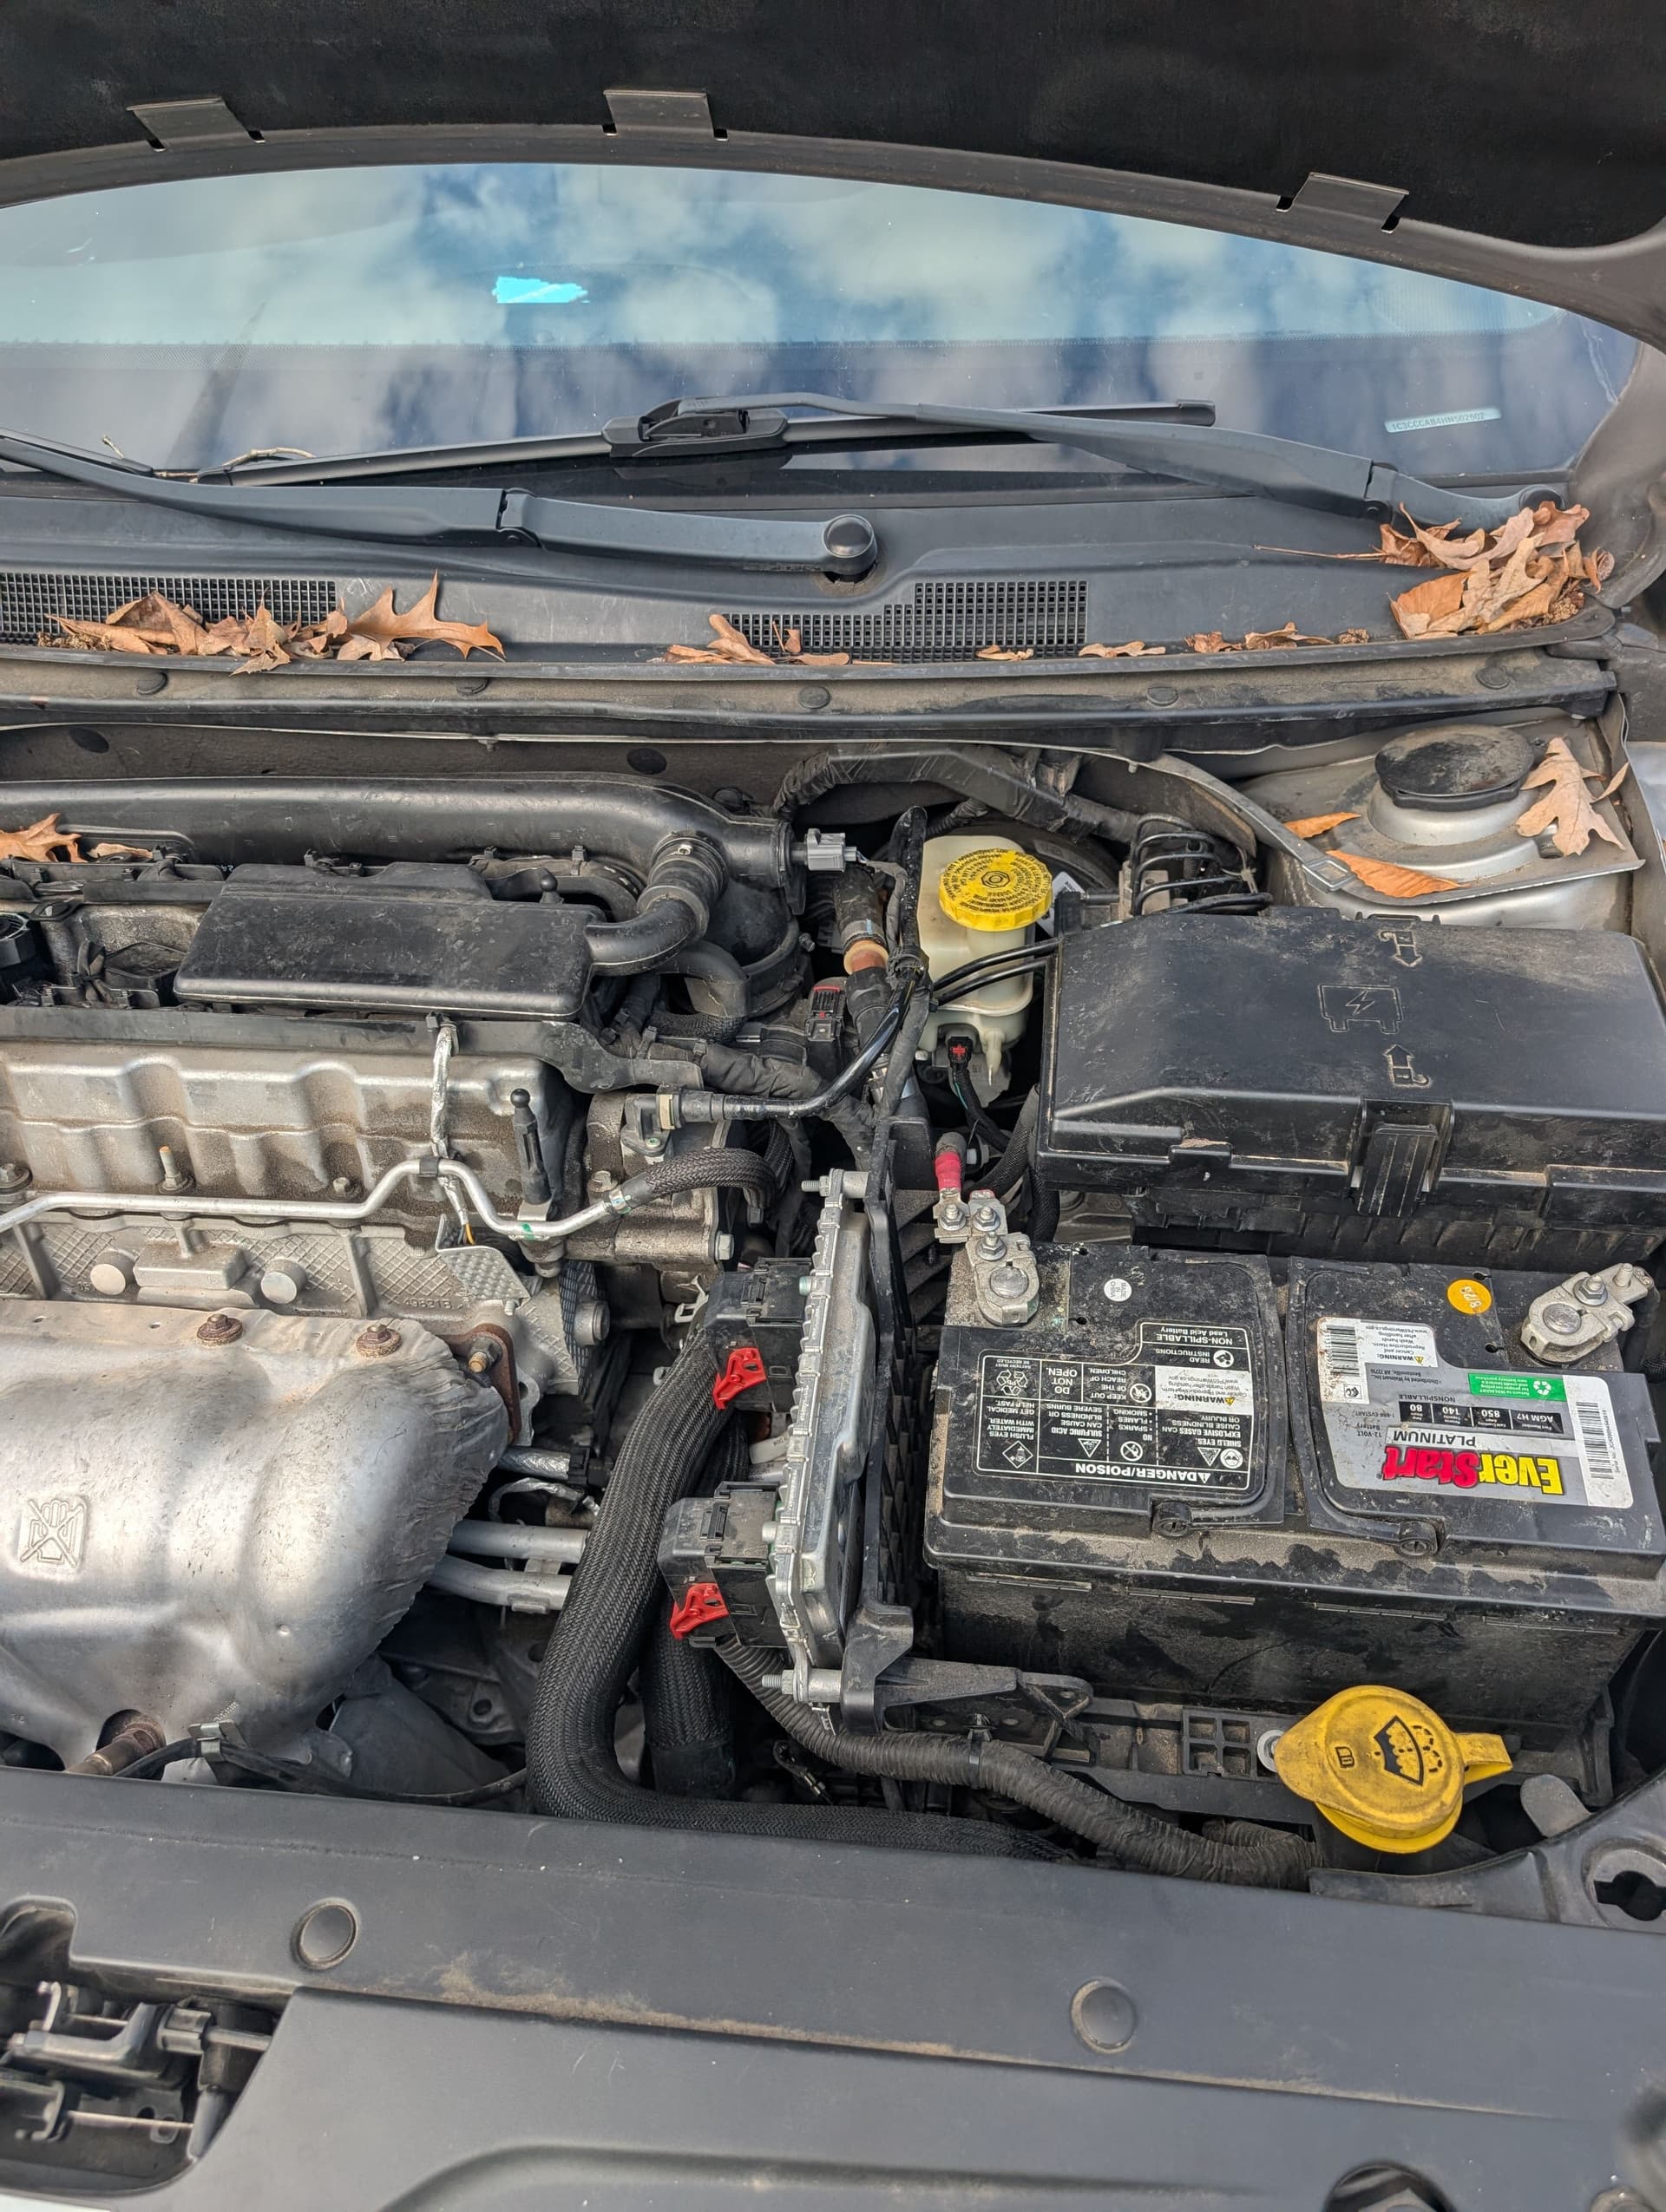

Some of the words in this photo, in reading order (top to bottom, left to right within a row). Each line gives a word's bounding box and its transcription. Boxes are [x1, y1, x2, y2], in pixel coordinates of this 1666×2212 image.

[1161, 1326, 1188, 1335] Battery
[1156, 1333, 1232, 1345] NON-SPILLABLE
[1046, 1367, 1078, 1378] OPEN.
[1088, 1367, 1126, 1376] CHILDREN.
[1052, 1378, 1073, 1386] NOT
[1054, 1386, 1070, 1395] DO
[1174, 1393, 1224, 1404] WARNING:
[1399, 1394, 1456, 1403] NONSPILLABLE
[1409, 1404, 1422, 1412] 80
[1061, 1412, 1102, 1421] BLINDNESS
[1481, 1409, 1499, 1417] 850
[1118, 1416, 1147, 1424] FLAMES
[1531, 1414, 1553, 1423] AGM
[987, 1424, 1034, 1433] IMMEDIATELY
[1357, 1423, 1380, 1431] Battery
[1010, 1431, 1034, 1440] FLUSH
[1069, 1428, 1102, 1436] SULFURIC
[1203, 1430, 1241, 1438] EXPLOSIVE
[1394, 1431, 1475, 1447] PLATINUM
[1076, 1463, 1197, 1482] DANGER/POISON
[1382, 1446, 1564, 1495] EverStart
